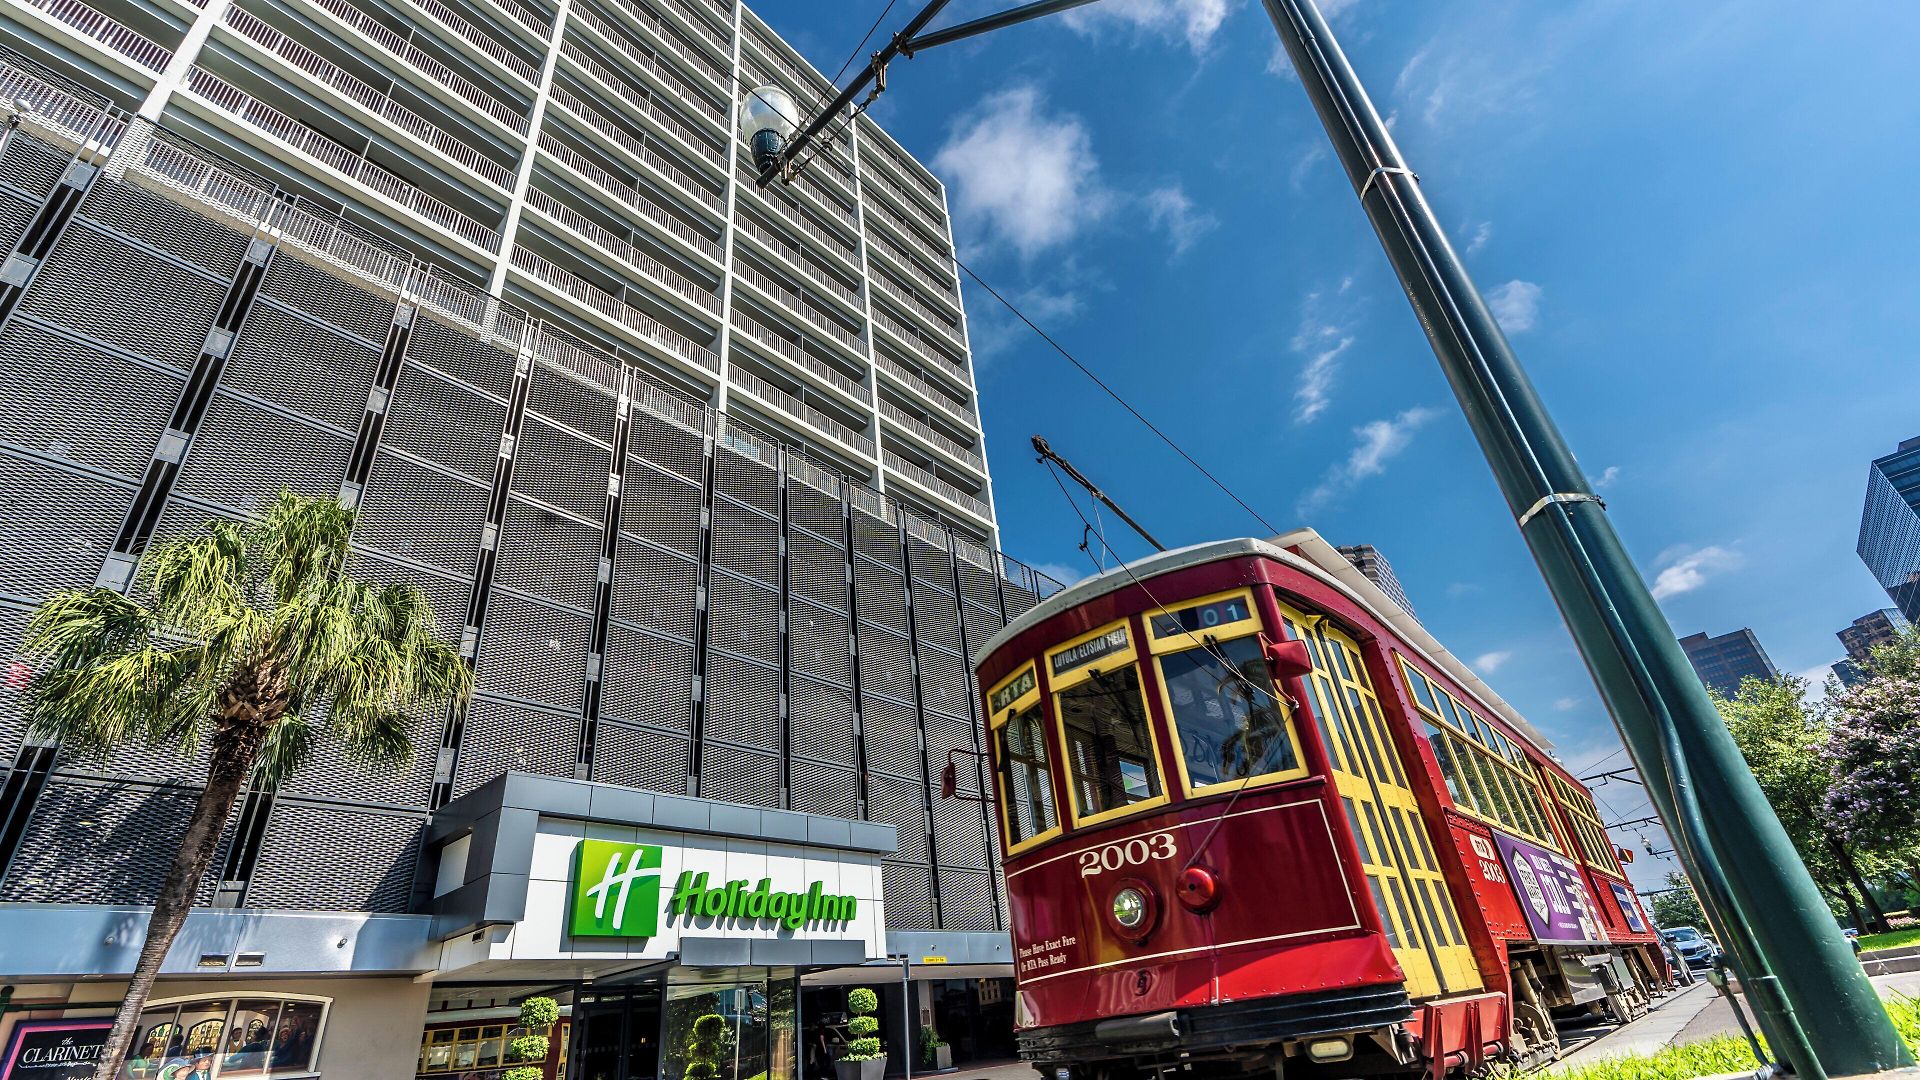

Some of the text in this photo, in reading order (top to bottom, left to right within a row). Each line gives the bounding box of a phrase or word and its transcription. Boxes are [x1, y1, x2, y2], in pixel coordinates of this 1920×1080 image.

[1000, 671, 1033, 706] RTA
[1078, 833, 1178, 879] 2003
[1478, 859, 1506, 884] 2003
[1044, 940, 1062, 951] Exact
[1061, 935, 1077, 947] Fare
[1026, 959, 1038, 971] RTA
[1037, 957, 1050, 968] Pass
[1049, 952, 1067, 964] Ready
[61, 1036, 74, 1046] the
[23, 1044, 104, 1064] CLARINET
